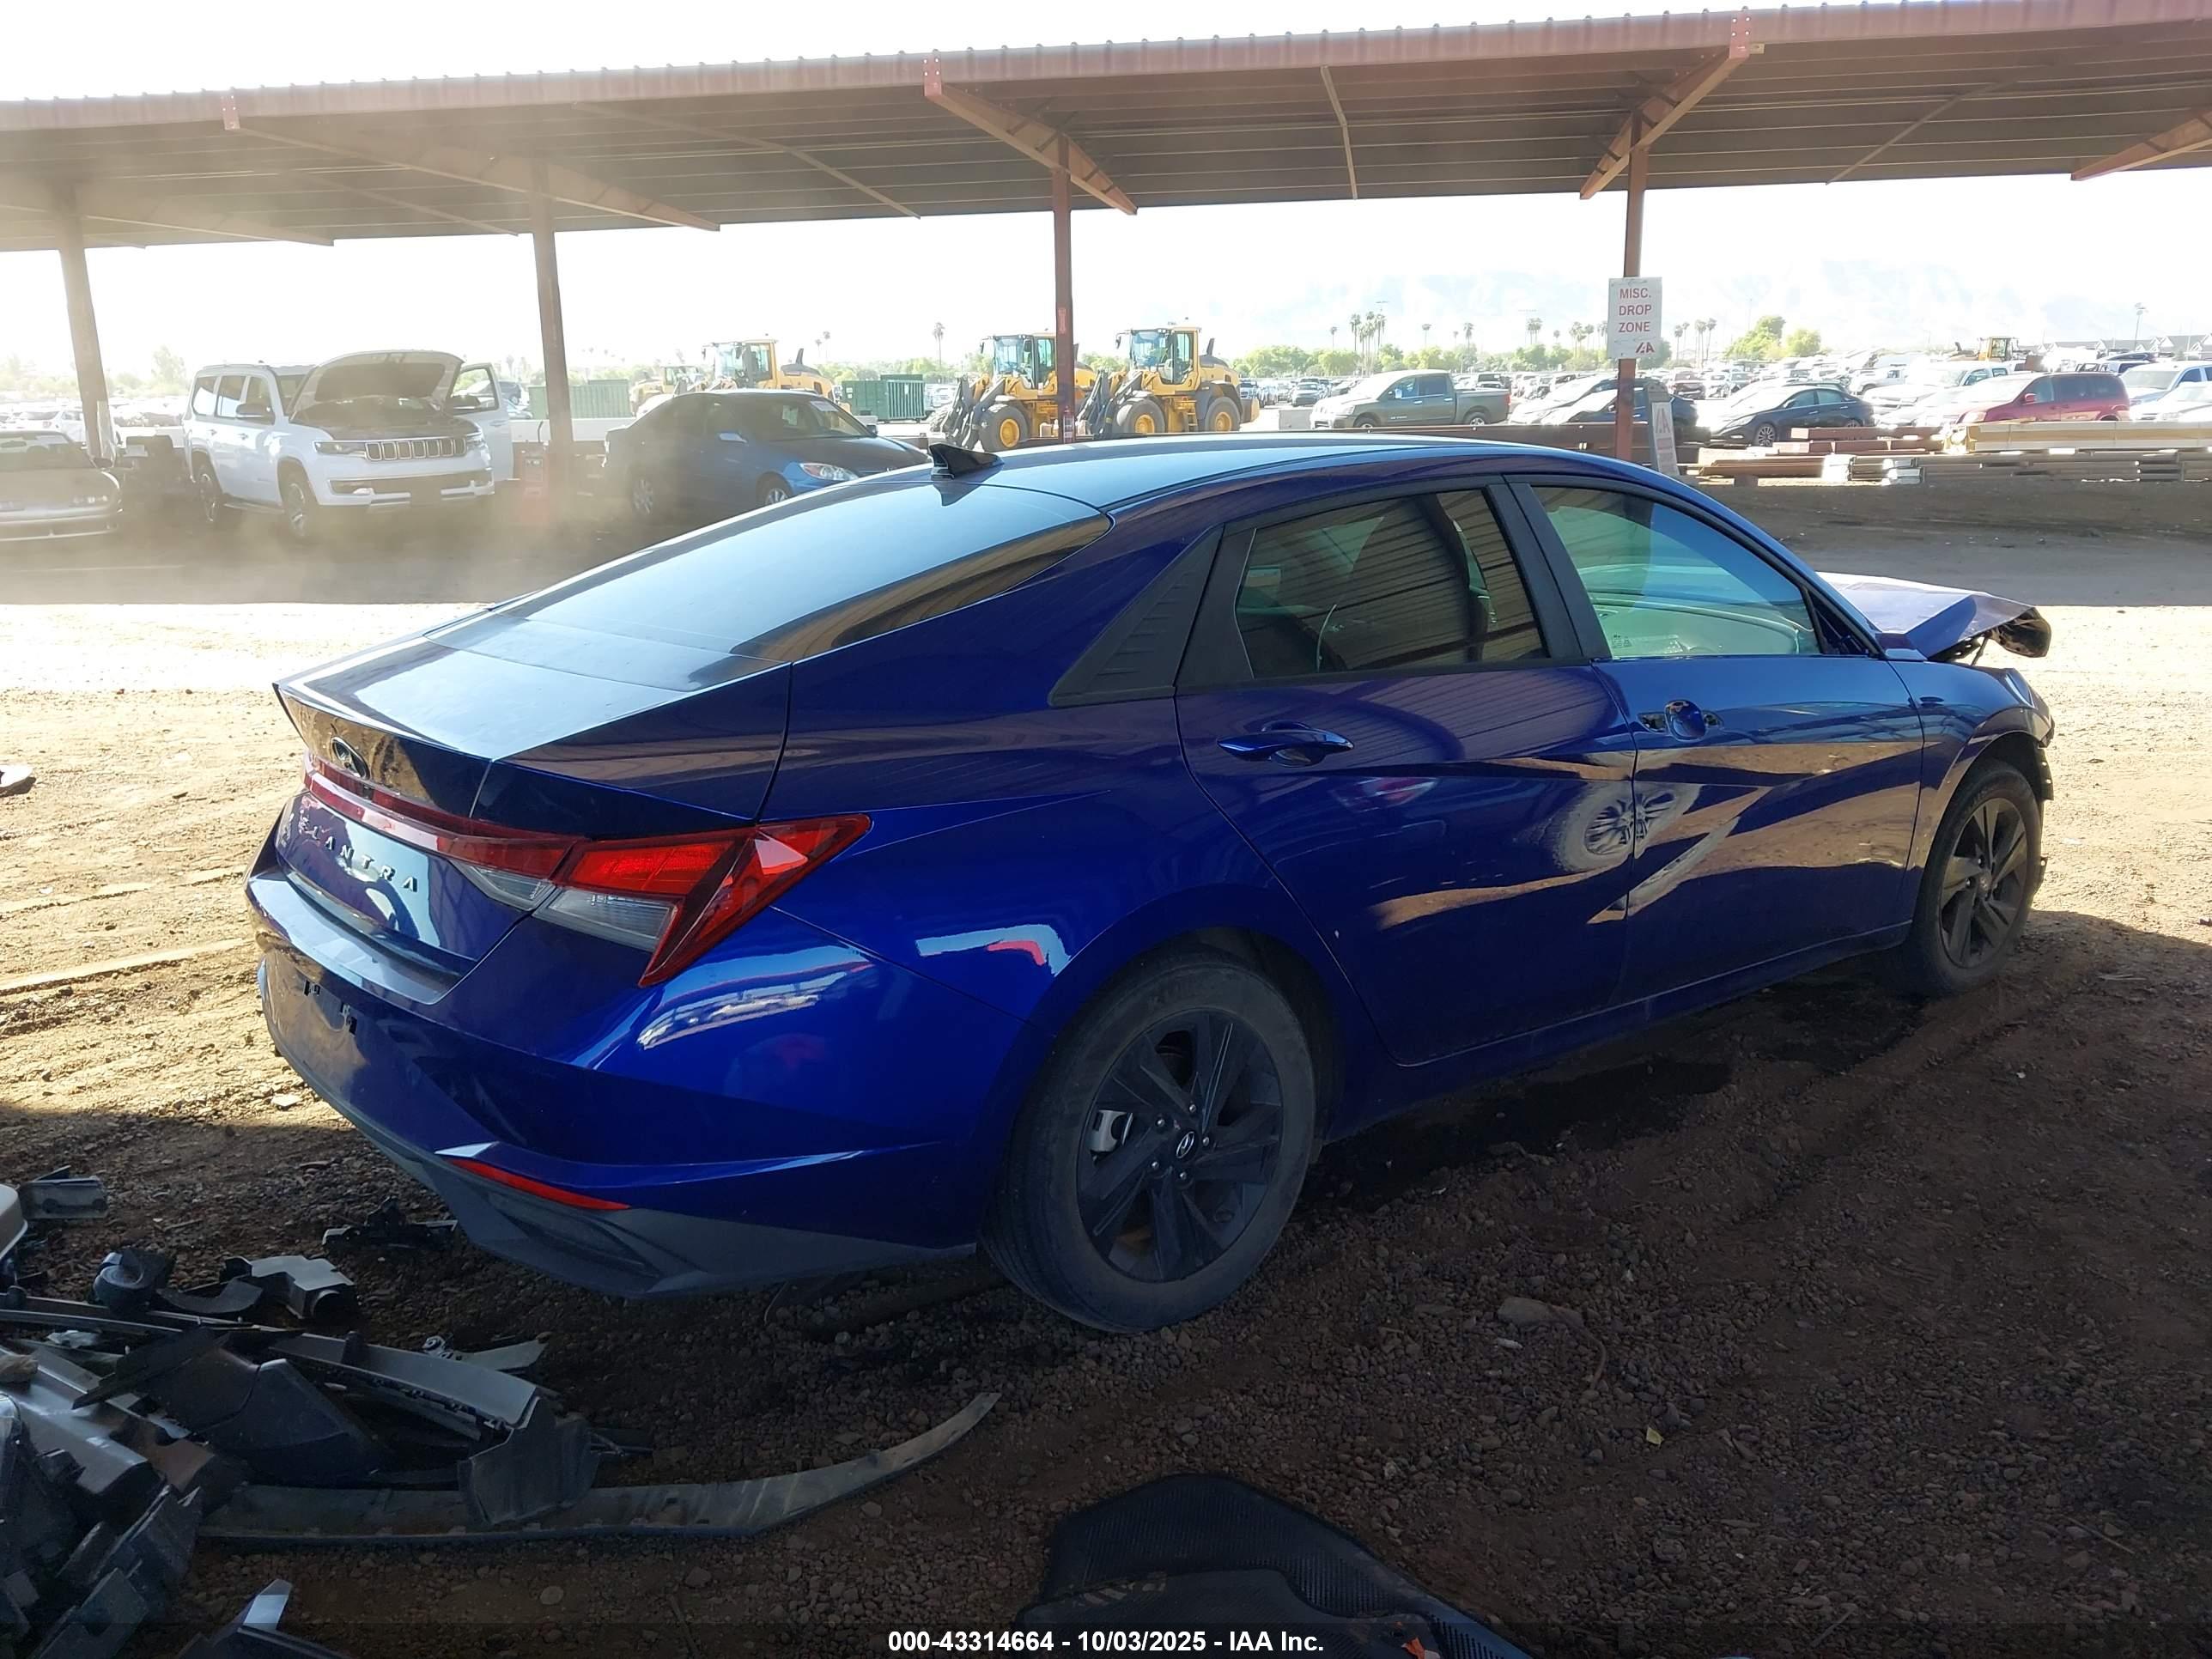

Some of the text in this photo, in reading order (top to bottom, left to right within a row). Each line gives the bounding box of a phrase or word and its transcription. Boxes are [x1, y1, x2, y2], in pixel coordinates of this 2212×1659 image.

[1620, 288, 1651, 299] MISC.
[1619, 305, 1652, 316] DROP
[1619, 322, 1650, 333] ZONE
